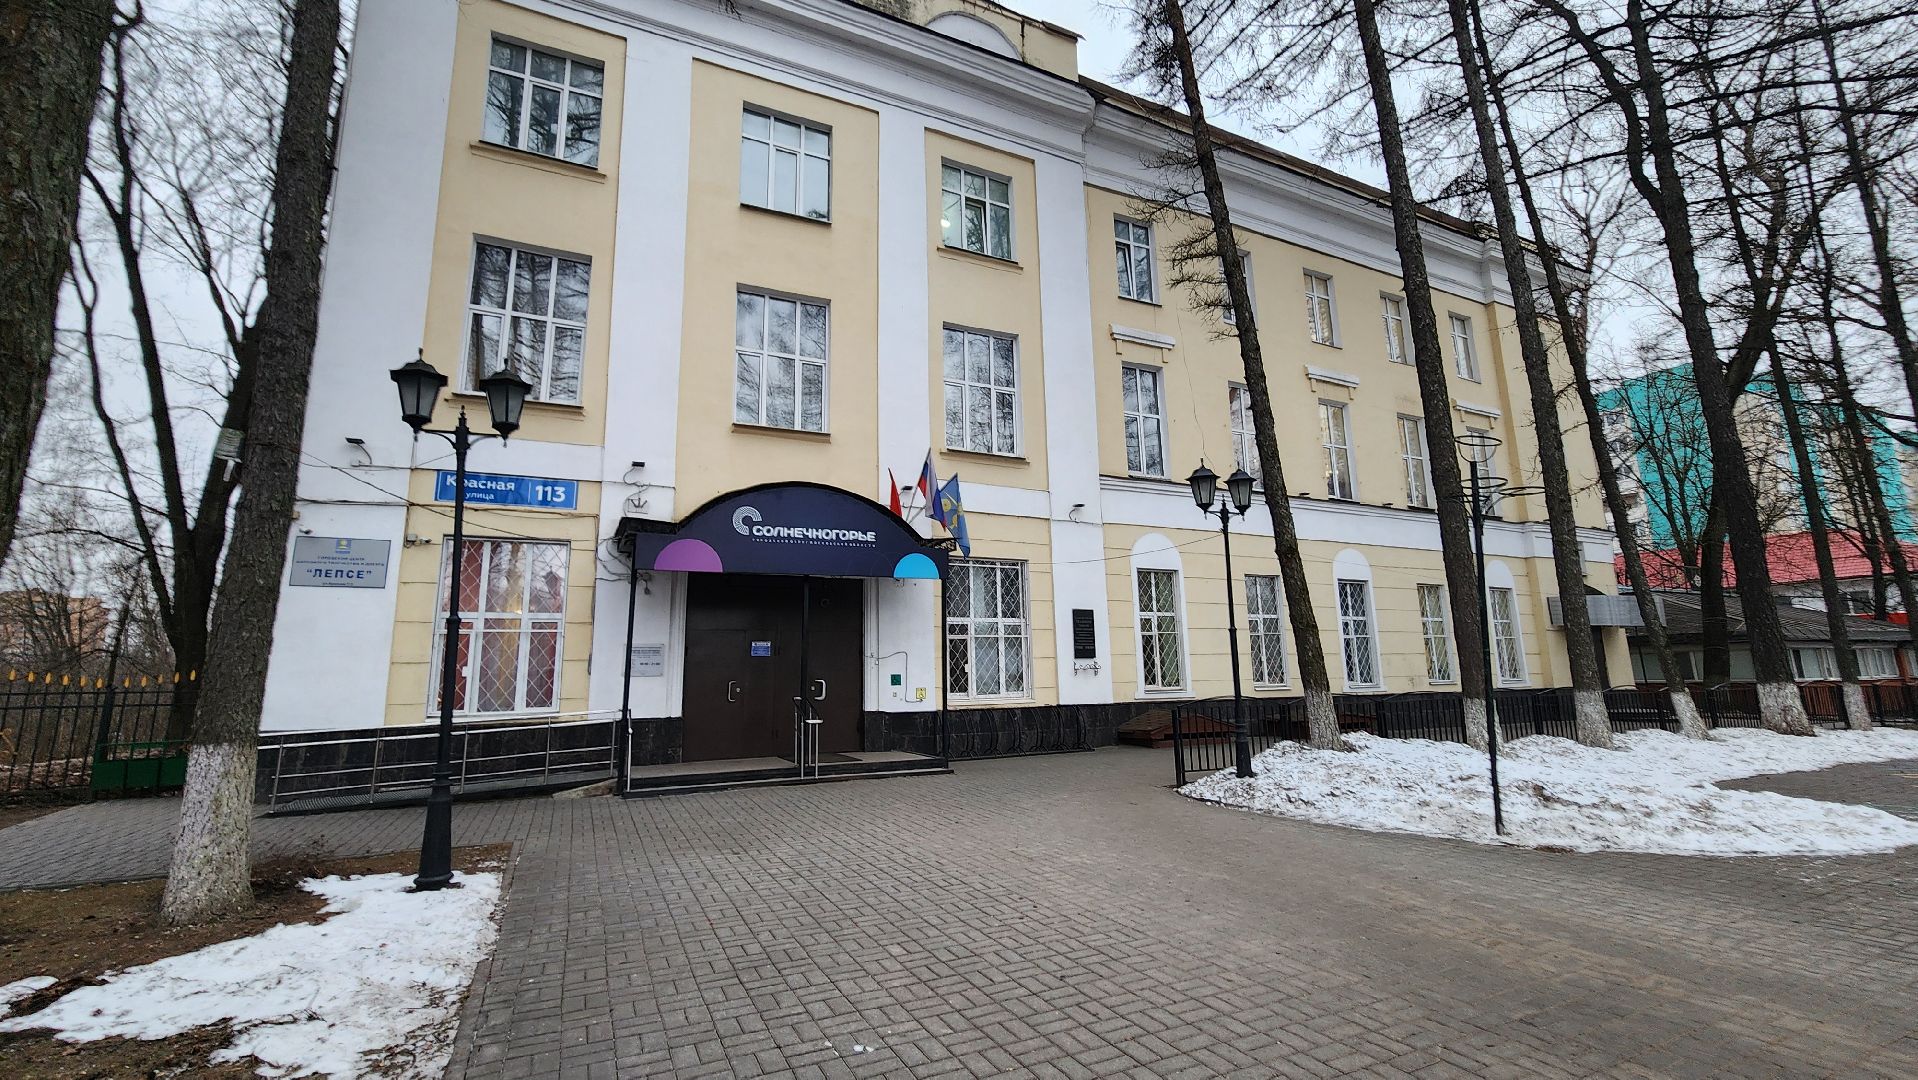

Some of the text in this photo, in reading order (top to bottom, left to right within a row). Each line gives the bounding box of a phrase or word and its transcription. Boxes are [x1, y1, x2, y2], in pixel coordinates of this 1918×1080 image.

[465, 491, 495, 500] улица
[535, 485, 566, 503] 113
[752, 525, 877, 542] СОЛНЕЧНОГОРЬЕ
